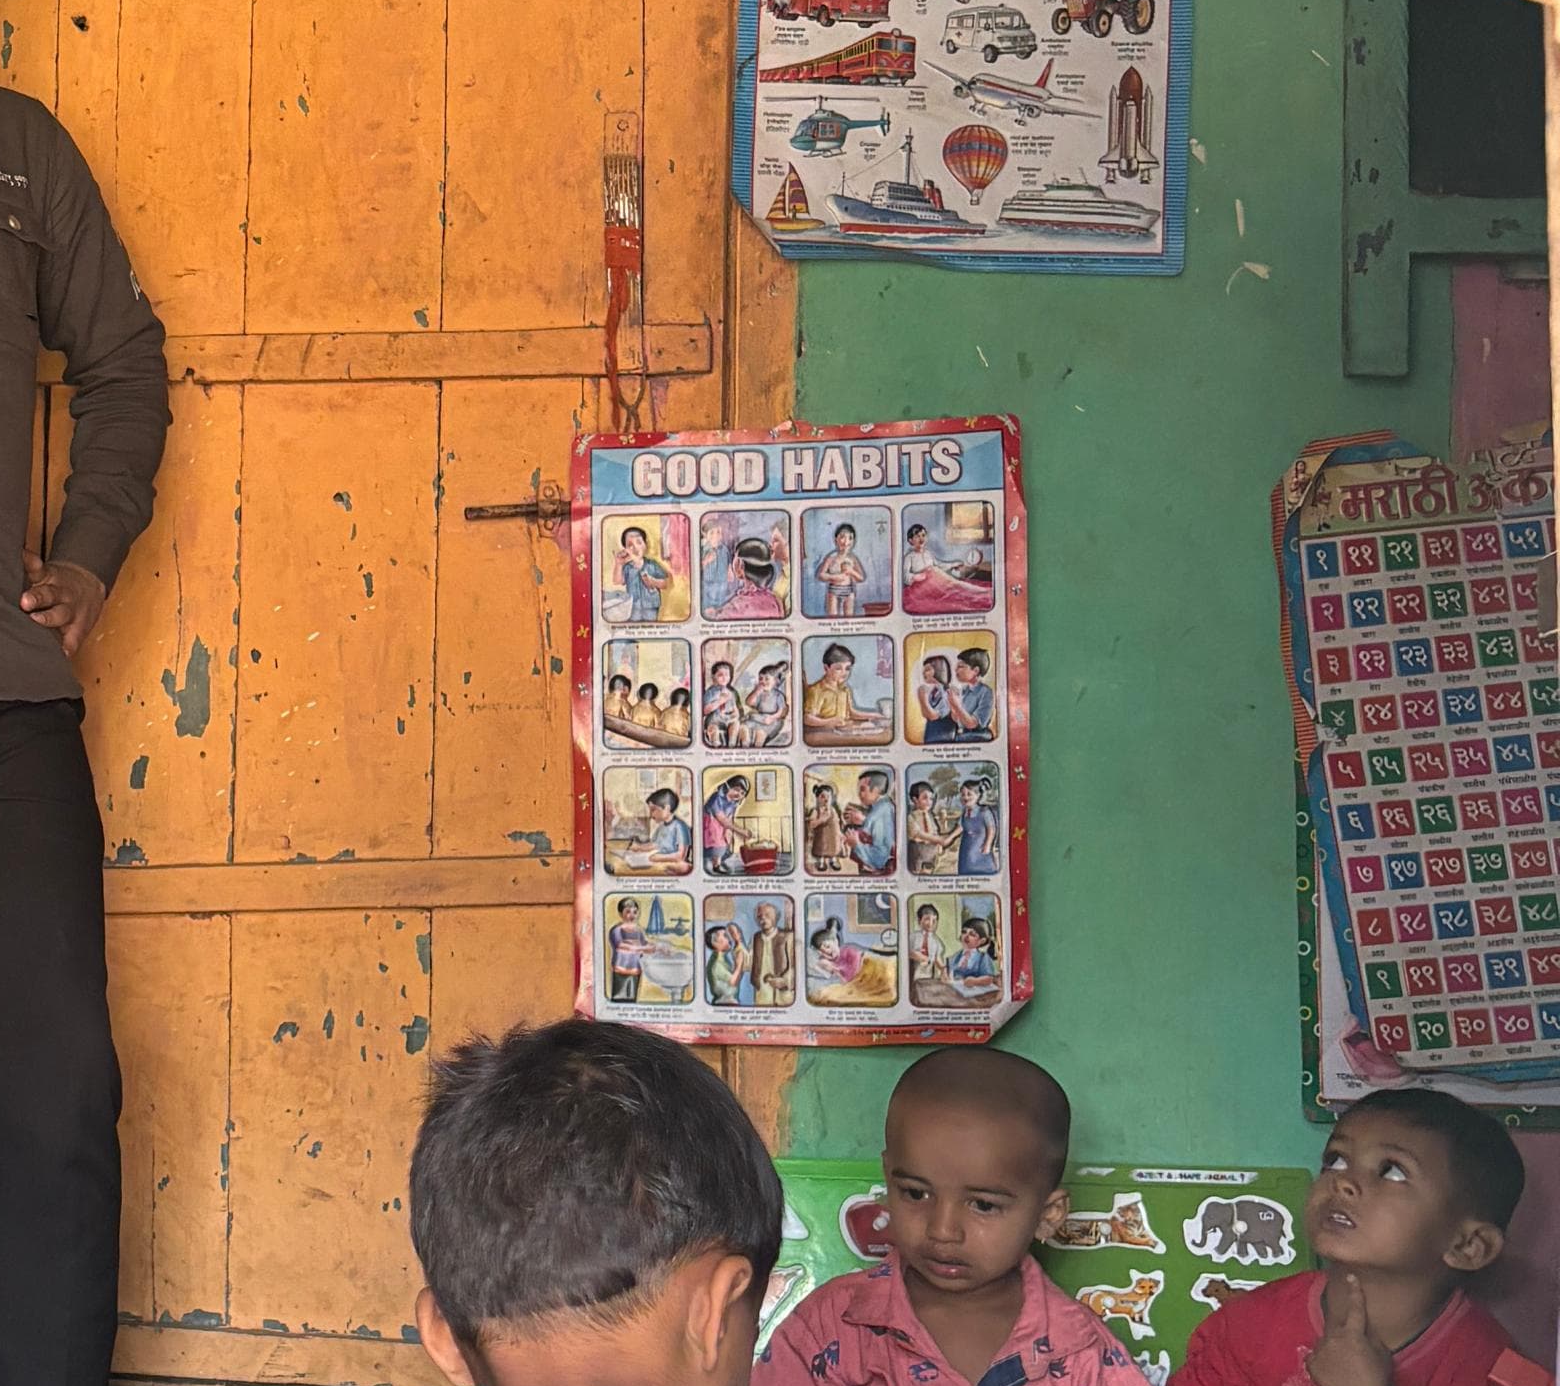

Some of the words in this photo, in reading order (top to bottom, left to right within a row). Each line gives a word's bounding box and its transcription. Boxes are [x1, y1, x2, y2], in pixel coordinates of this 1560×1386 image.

[631, 449, 769, 497] GOOD
[783, 439, 964, 493] HABITS
[1339, 463, 1459, 522] मराठी
[1316, 549, 1328, 571] १
[1347, 544, 1374, 567] ११
[1387, 540, 1414, 563] २१
[1427, 536, 1454, 559] ३१
[1466, 533, 1498, 554] ४१
[1508, 527, 1539, 550] ५१
[1323, 603, 1334, 622] २
[1352, 597, 1380, 620] १२
[1392, 593, 1421, 615] २२
[1433, 588, 1462, 612] ३२
[1473, 584, 1506, 605] ४२
[1327, 654, 1338, 676] ३
[1358, 649, 1386, 672] १३
[1399, 645, 1428, 667] २३
[1440, 640, 1469, 664] ३३
[1480, 636, 1514, 658] ४३
[1330, 710, 1345, 726] ४
[1363, 702, 1392, 726] १४
[1404, 698, 1435, 720] २४
[1446, 693, 1476, 717] ३४
[1488, 691, 1522, 711] ४४
[1338, 760, 1356, 779] ५
[1371, 756, 1401, 778] १५
[1411, 751, 1445, 773] २५
[1453, 746, 1487, 769] ३५
[1496, 743, 1531, 762] ४५
[1348, 808, 1365, 832] ६
[1382, 807, 1410, 830] १६
[1420, 803, 1453, 825] २६
[1463, 799, 1495, 822] ३६
[1505, 795, 1539, 815] ४६
[1356, 866, 1374, 884] ७
[1390, 860, 1417, 882] १७
[1428, 856, 1461, 878] २७
[1470, 853, 1503, 874] ३७
[1514, 851, 1547, 869] ४७
[1368, 918, 1382, 936] ८
[1400, 912, 1427, 934] १८
[1438, 908, 1468, 931] २८
[1479, 904, 1512, 928] ३८
[1525, 902, 1556, 920] ४८
[1380, 1023, 1404, 1045] १०
[1418, 1021, 1444, 1041] २०
[1456, 1016, 1486, 1039] ३०
[1498, 1015, 1530, 1033] ४०
